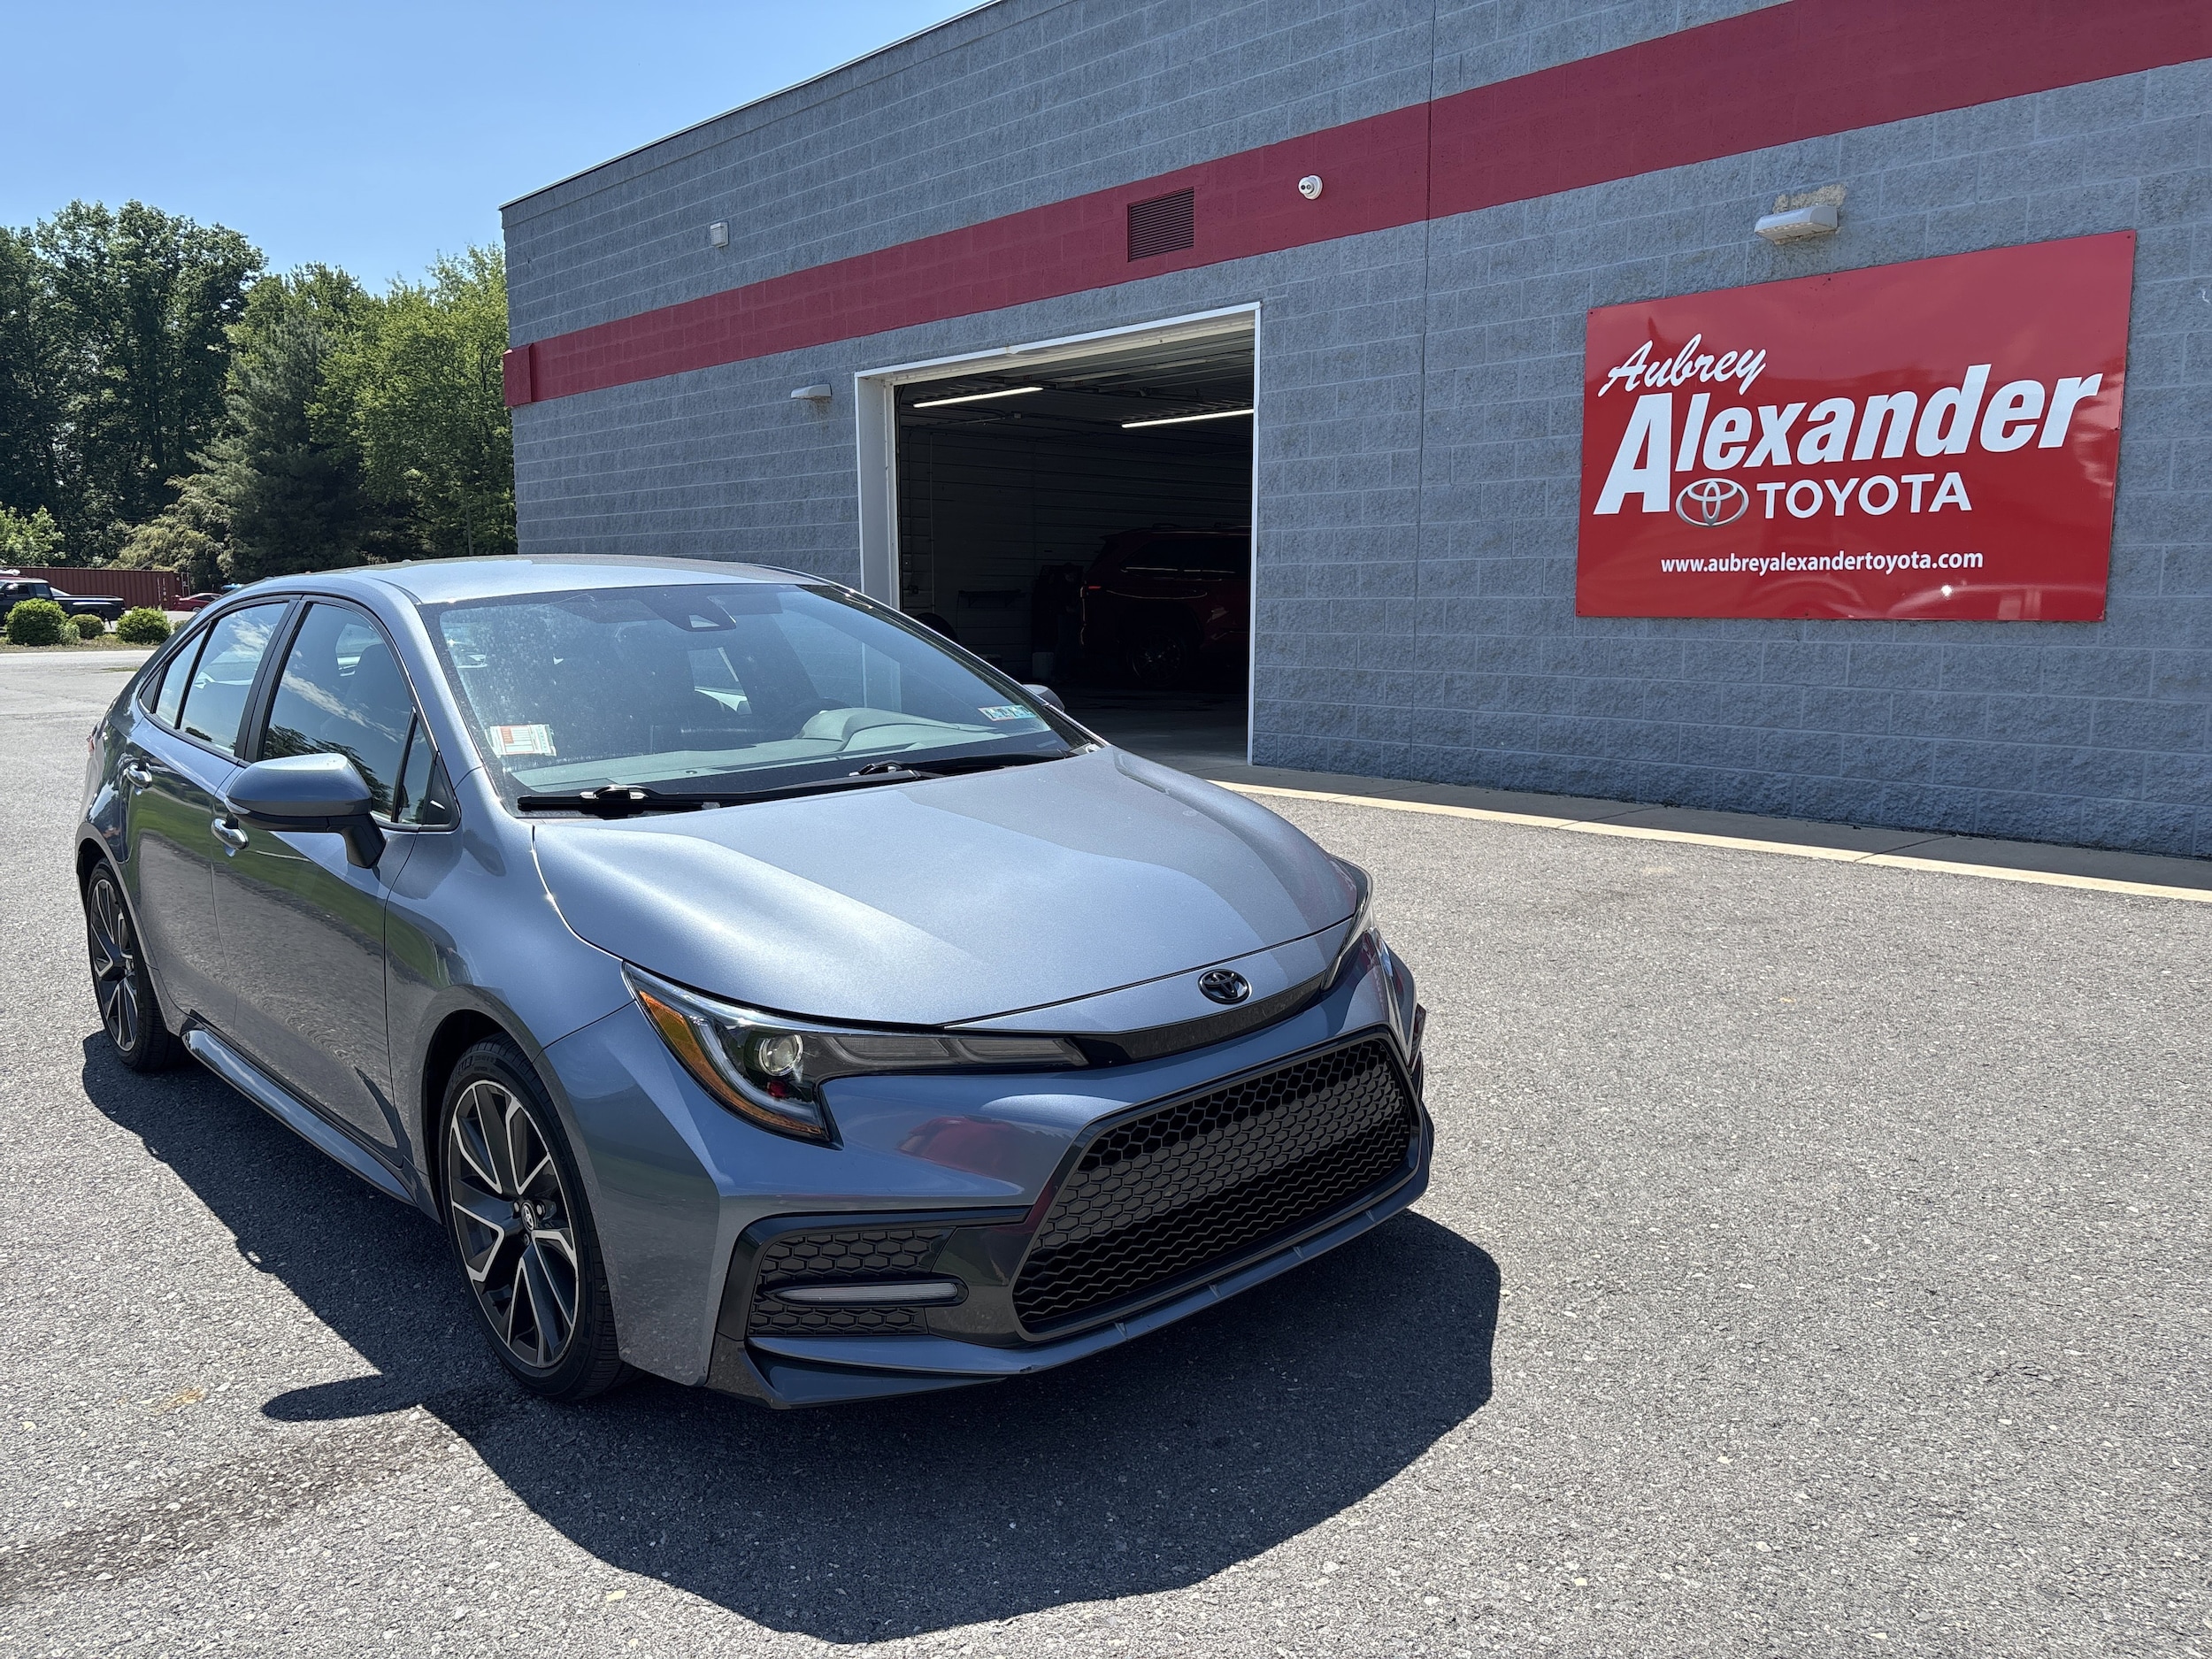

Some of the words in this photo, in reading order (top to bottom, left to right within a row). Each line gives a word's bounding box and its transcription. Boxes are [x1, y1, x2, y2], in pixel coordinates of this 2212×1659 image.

[1597, 333, 1767, 397] Aubrey
[1593, 363, 2104, 516] Alexander
[1755, 472, 1973, 519] TOYOTA
[1660, 549, 1984, 577] www.aubreyalexandertoyota.com
